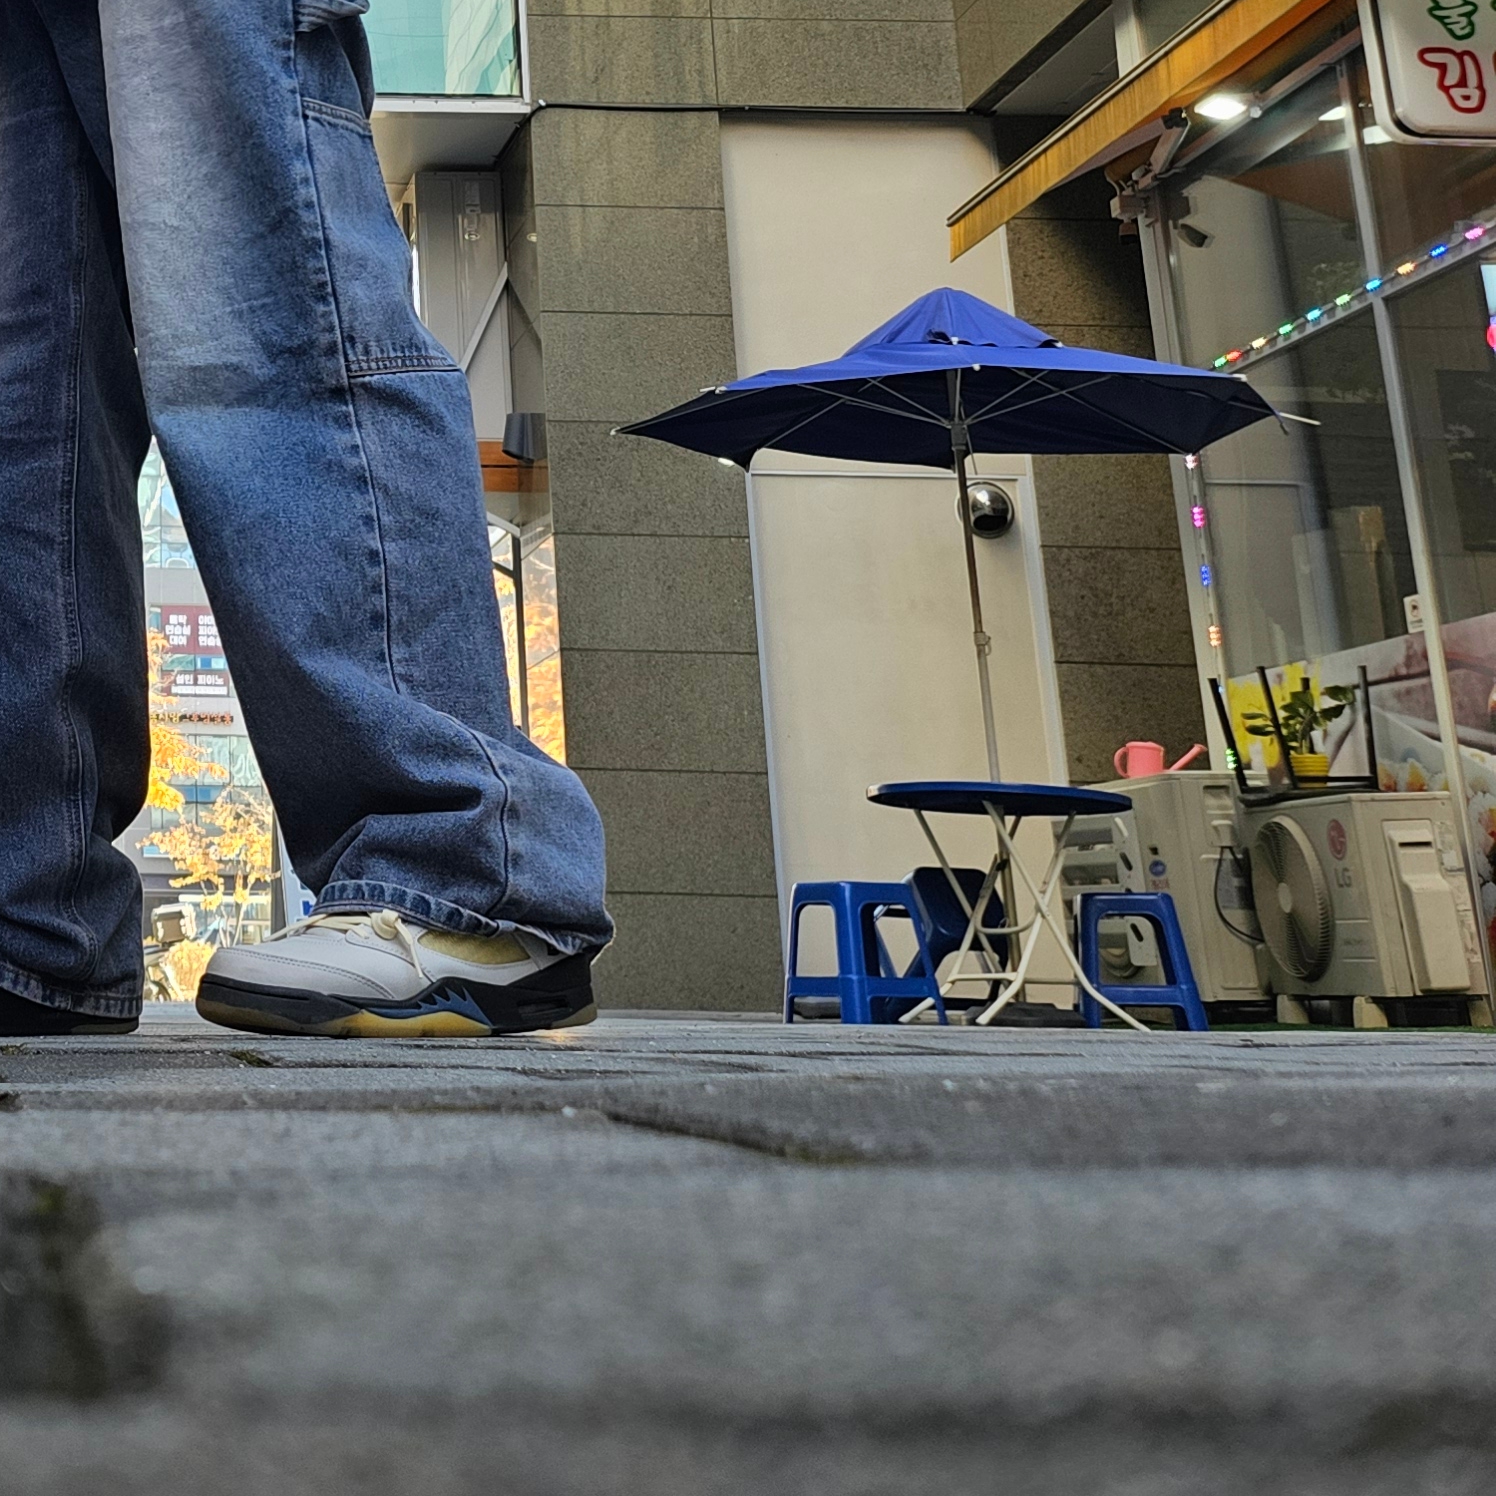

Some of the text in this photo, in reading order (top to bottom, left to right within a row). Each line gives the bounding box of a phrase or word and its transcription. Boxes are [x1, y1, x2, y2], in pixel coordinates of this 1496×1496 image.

[1417, 47, 1496, 114] 김
[197, 675, 224, 685] 피아노
[1334, 867, 1353, 889] LG
